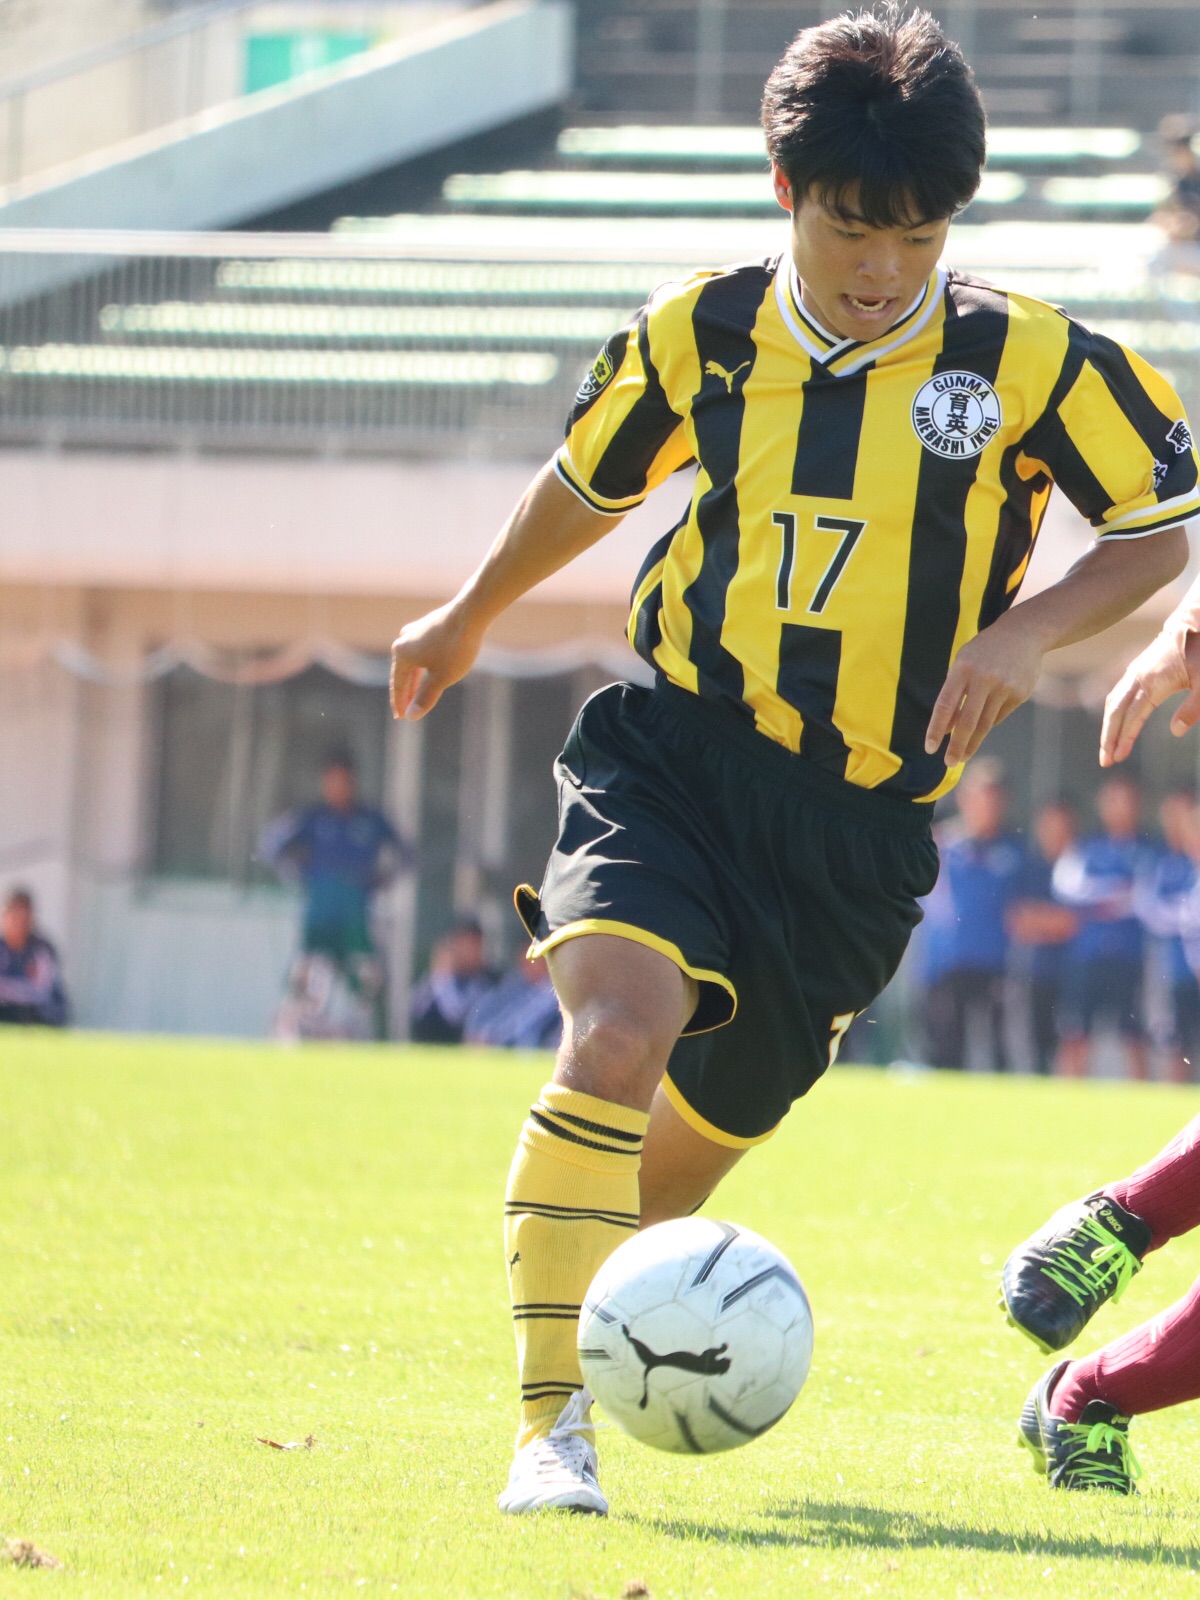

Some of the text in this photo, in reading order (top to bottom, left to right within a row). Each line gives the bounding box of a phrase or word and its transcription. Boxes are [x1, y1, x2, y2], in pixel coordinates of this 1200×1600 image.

[932, 375, 990, 402] GUNMA
[915, 406, 998, 454] MAEBASHI IKUEI
[945, 391, 971, 436] 育英
[770, 510, 868, 615] 17
